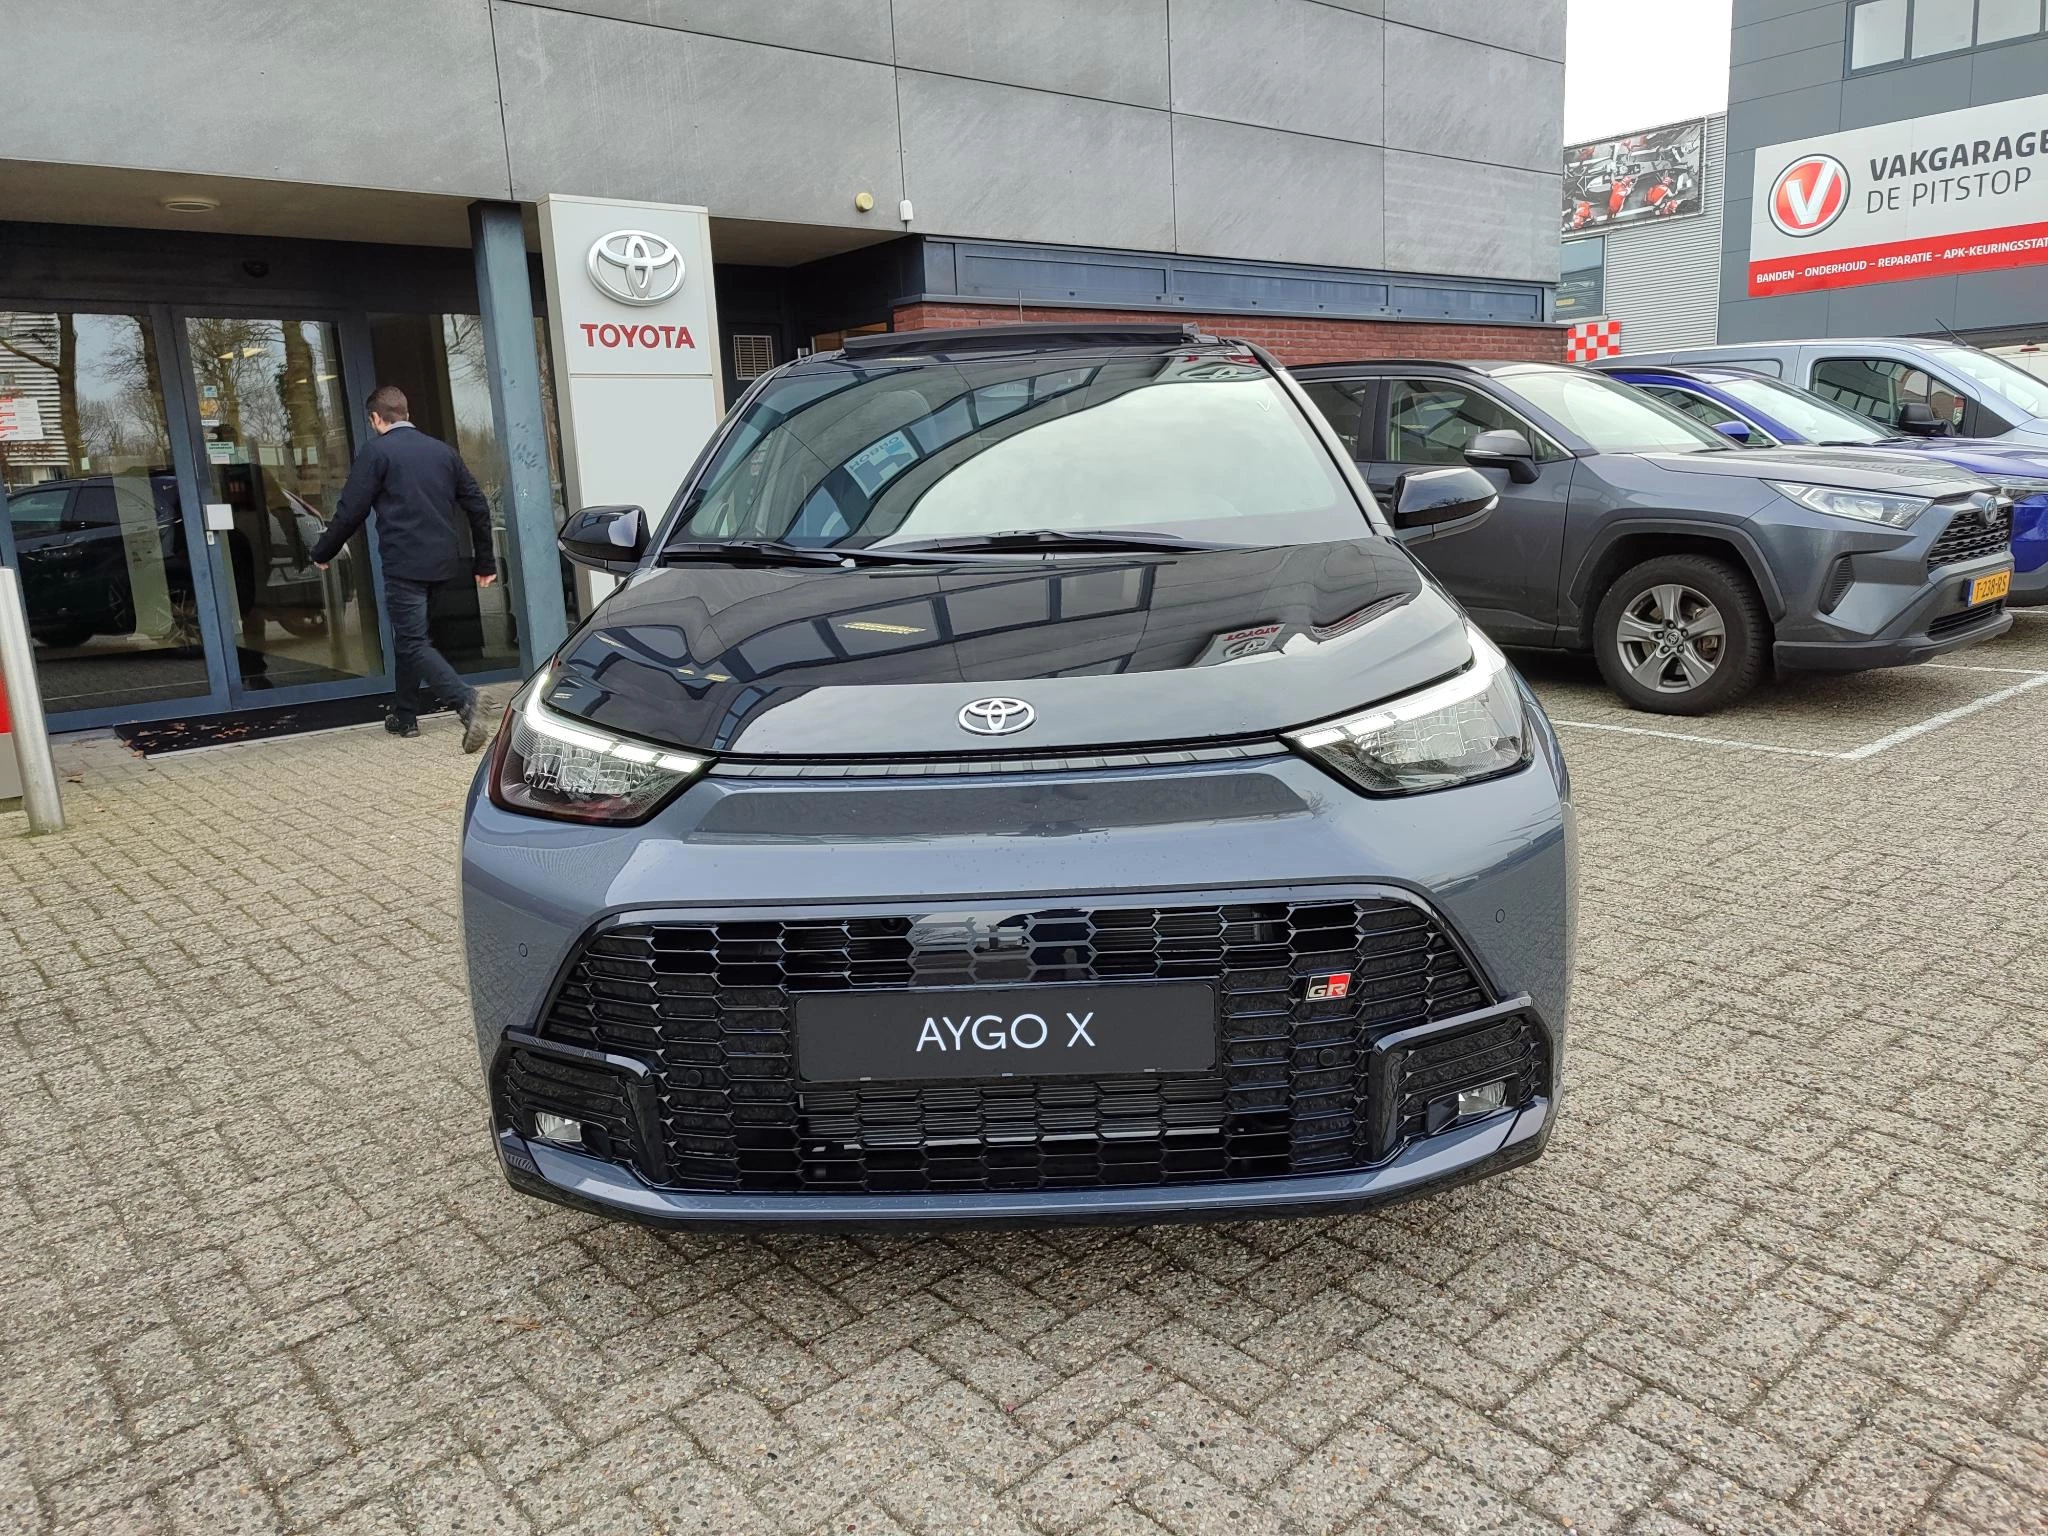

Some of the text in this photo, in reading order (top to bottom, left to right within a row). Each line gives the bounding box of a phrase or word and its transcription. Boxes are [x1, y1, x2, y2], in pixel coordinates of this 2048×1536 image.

[1870, 129, 2048, 181] VAKGARAGE
[1867, 166, 2032, 214] DE PITSTOP
[1756, 270, 1795, 283] BANDEN
[1804, 260, 1867, 277] ONDERHOUD
[1877, 251, 1933, 268] REPARATIE
[579, 323, 696, 349] TOYOTA
[1308, 983, 1346, 998] GR
[916, 1012, 1096, 1052] AYGO X
